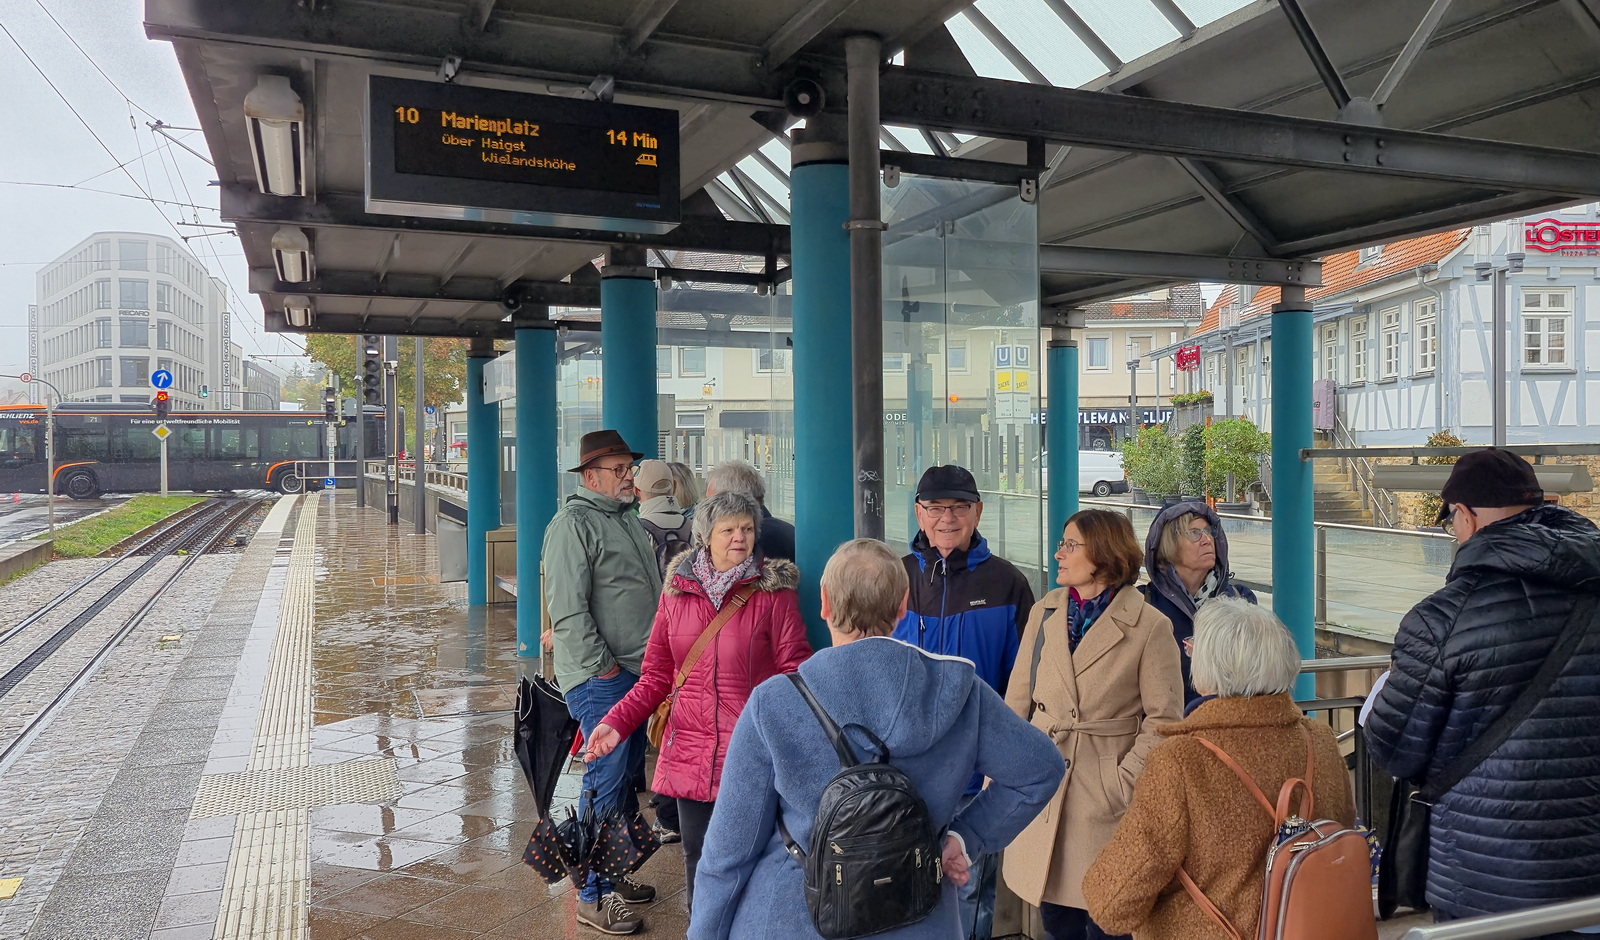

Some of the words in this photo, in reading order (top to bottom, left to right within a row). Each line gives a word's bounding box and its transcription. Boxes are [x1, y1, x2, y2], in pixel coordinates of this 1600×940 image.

[395, 106, 420, 124] 10
[441, 111, 540, 137] Marienplatz
[606, 129, 627, 146] 14
[633, 132, 658, 149] Min
[442, 134, 475, 147] über
[481, 137, 526, 153] Haigst
[481, 152, 577, 171] Wielandshöhe
[1526, 226, 1600, 245] L'OSTE
[998, 348, 1009, 362] U
[1017, 348, 1027, 362] U
